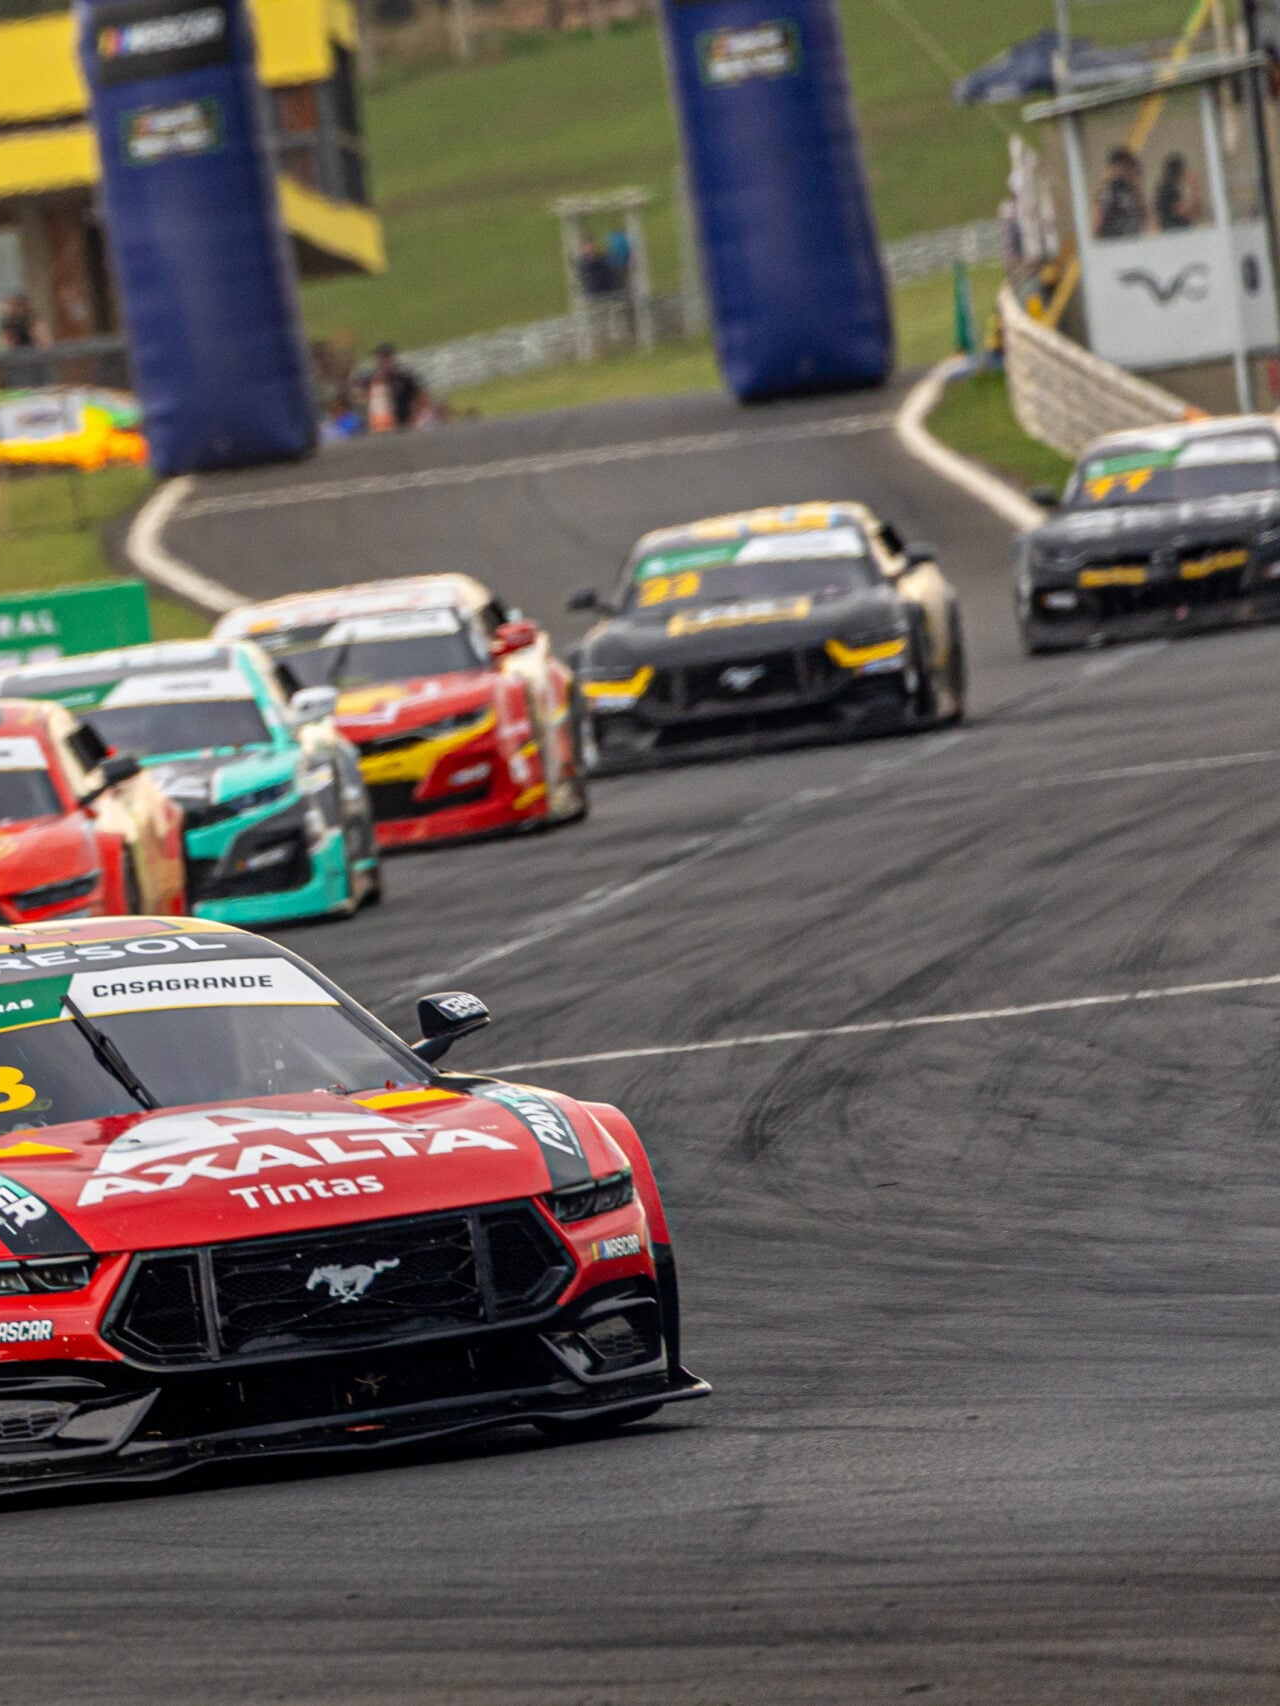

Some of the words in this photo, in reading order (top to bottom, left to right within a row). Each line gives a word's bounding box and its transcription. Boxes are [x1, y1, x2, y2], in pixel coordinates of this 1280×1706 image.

[92, 975, 275, 1000] CASAGRANDE
[76, 1127, 517, 1207] AXALTA
[230, 1175, 385, 1209] Tintas
[604, 1234, 641, 1258] NASCAR
